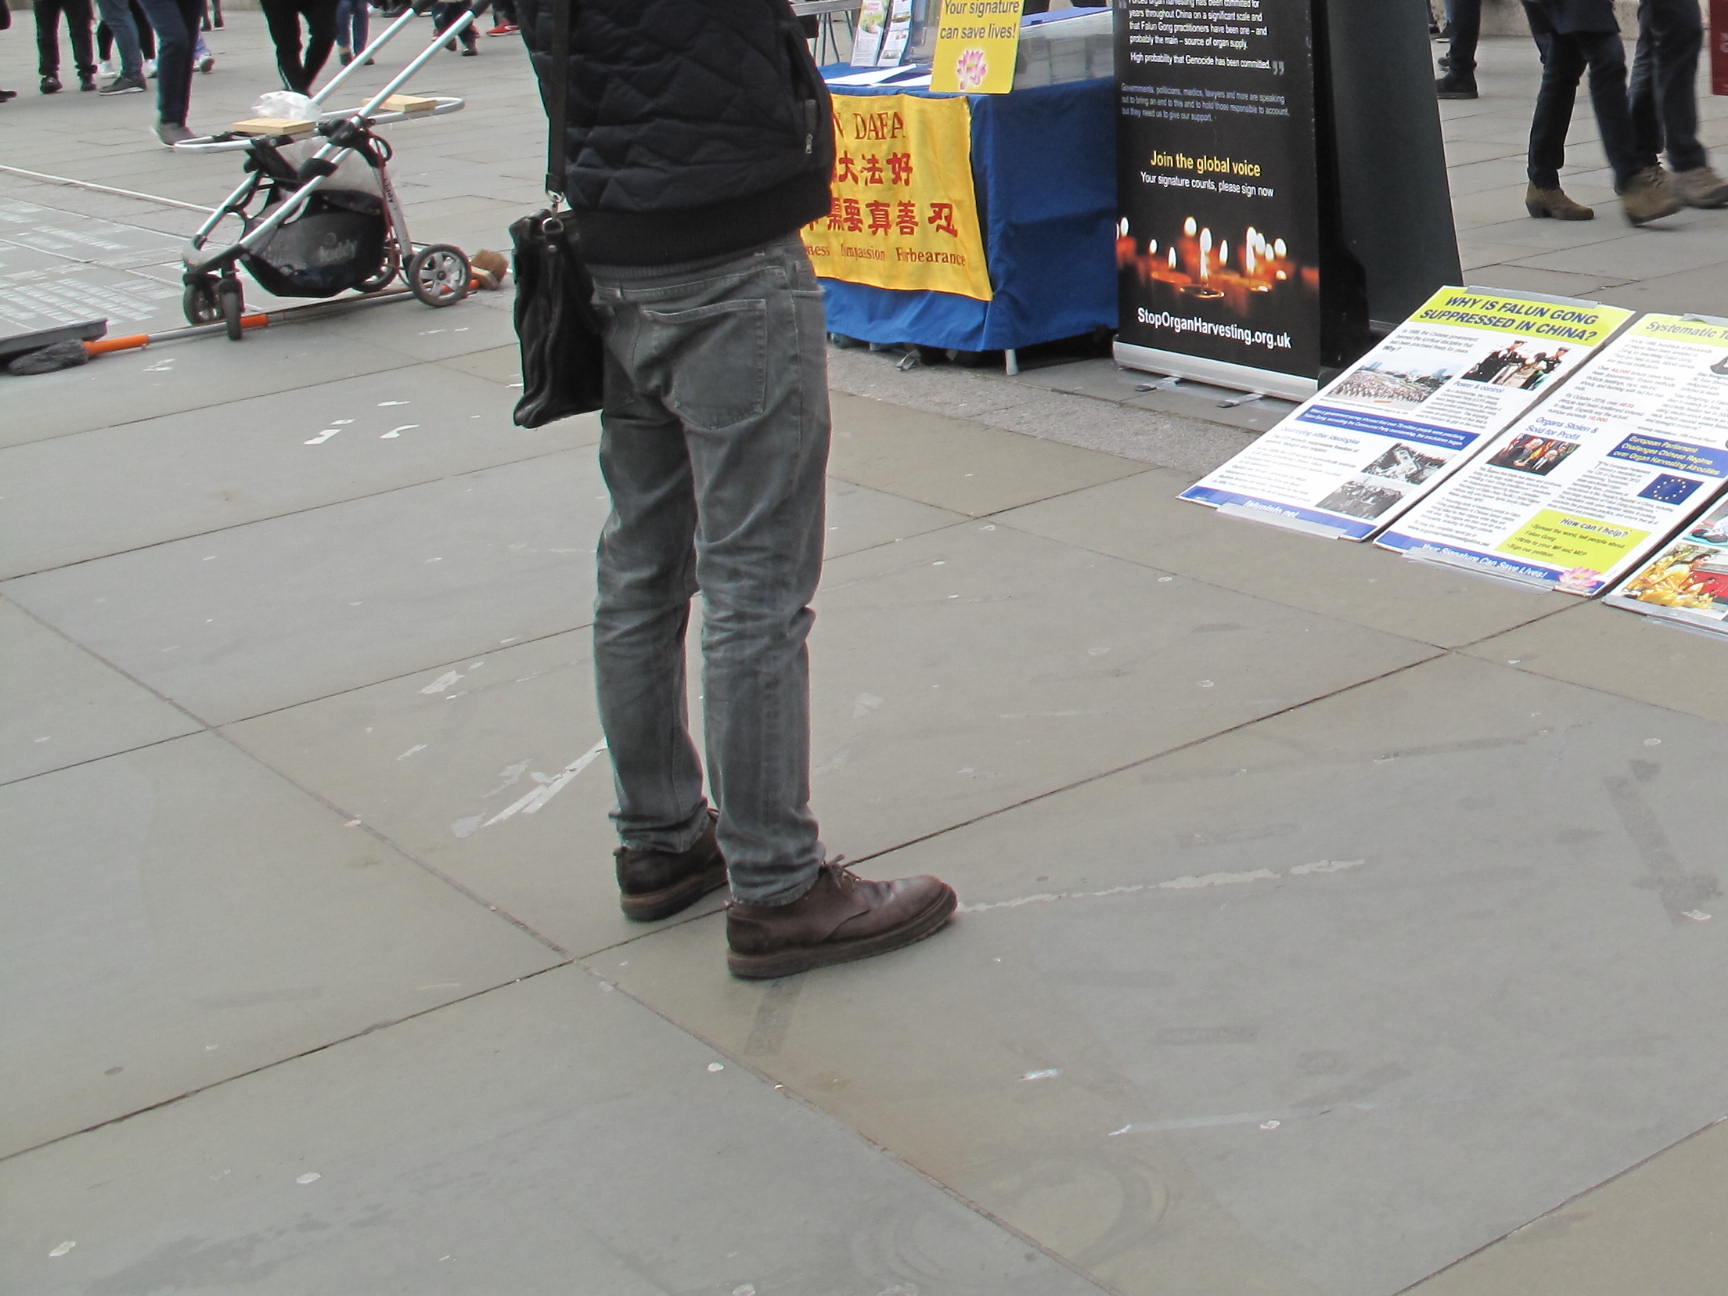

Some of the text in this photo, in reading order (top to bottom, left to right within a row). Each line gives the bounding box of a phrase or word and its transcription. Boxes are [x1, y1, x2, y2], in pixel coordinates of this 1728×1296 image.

[945, 0, 967, 14] Your
[940, 23, 1016, 39] can save lives!
[853, 112, 905, 140] DAFA
[833, 151, 913, 186] 大法好
[1151, 151, 1260, 176] Join the global voice
[1141, 172, 1273, 197] Your signature counts, please sign now
[809, 197, 958, 237] 需要真善忍
[1446, 296, 1599, 324] WHY IS FALUN GONG
[1138, 308, 1291, 349] StopOrganHarvesting.org.uk
[1420, 310, 1598, 341] SUPPRESSED IN CHINA?
[1646, 322, 1717, 338] Systematic
[1560, 518, 1578, 527] How
[1480, 557, 1497, 566] Can
[1497, 562, 1519, 571] Save
